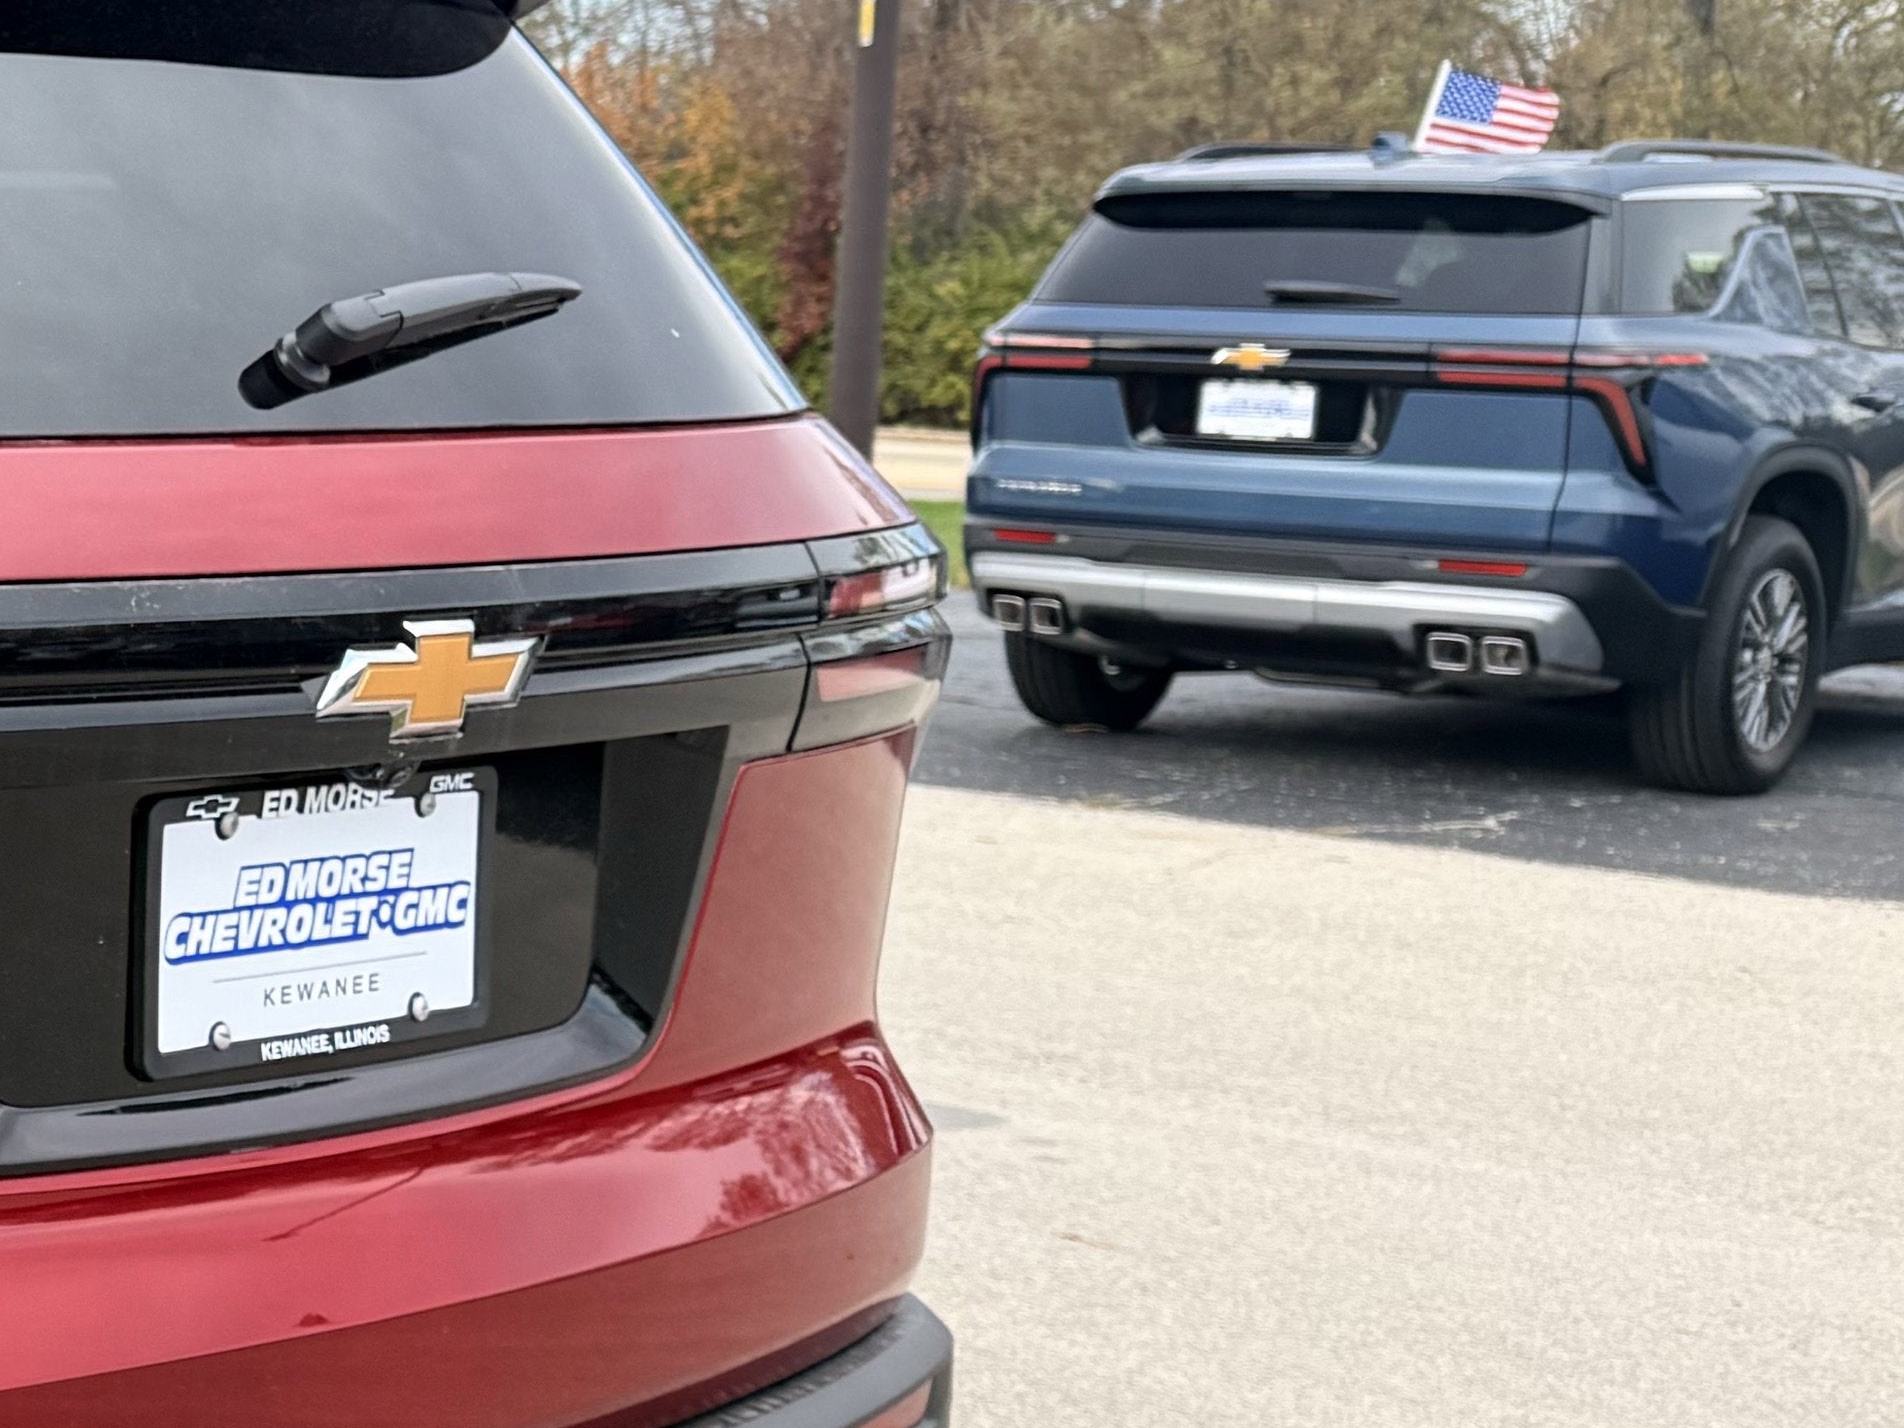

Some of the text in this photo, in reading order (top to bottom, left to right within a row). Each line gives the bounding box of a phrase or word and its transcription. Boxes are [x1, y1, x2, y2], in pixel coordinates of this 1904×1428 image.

[429, 772, 475, 793] GMC
[261, 789, 299, 819] ED
[234, 849, 414, 909] ED MORSE
[262, 972, 381, 1008] KEWANEE
[333, 1023, 391, 1050] ILLINOIS
